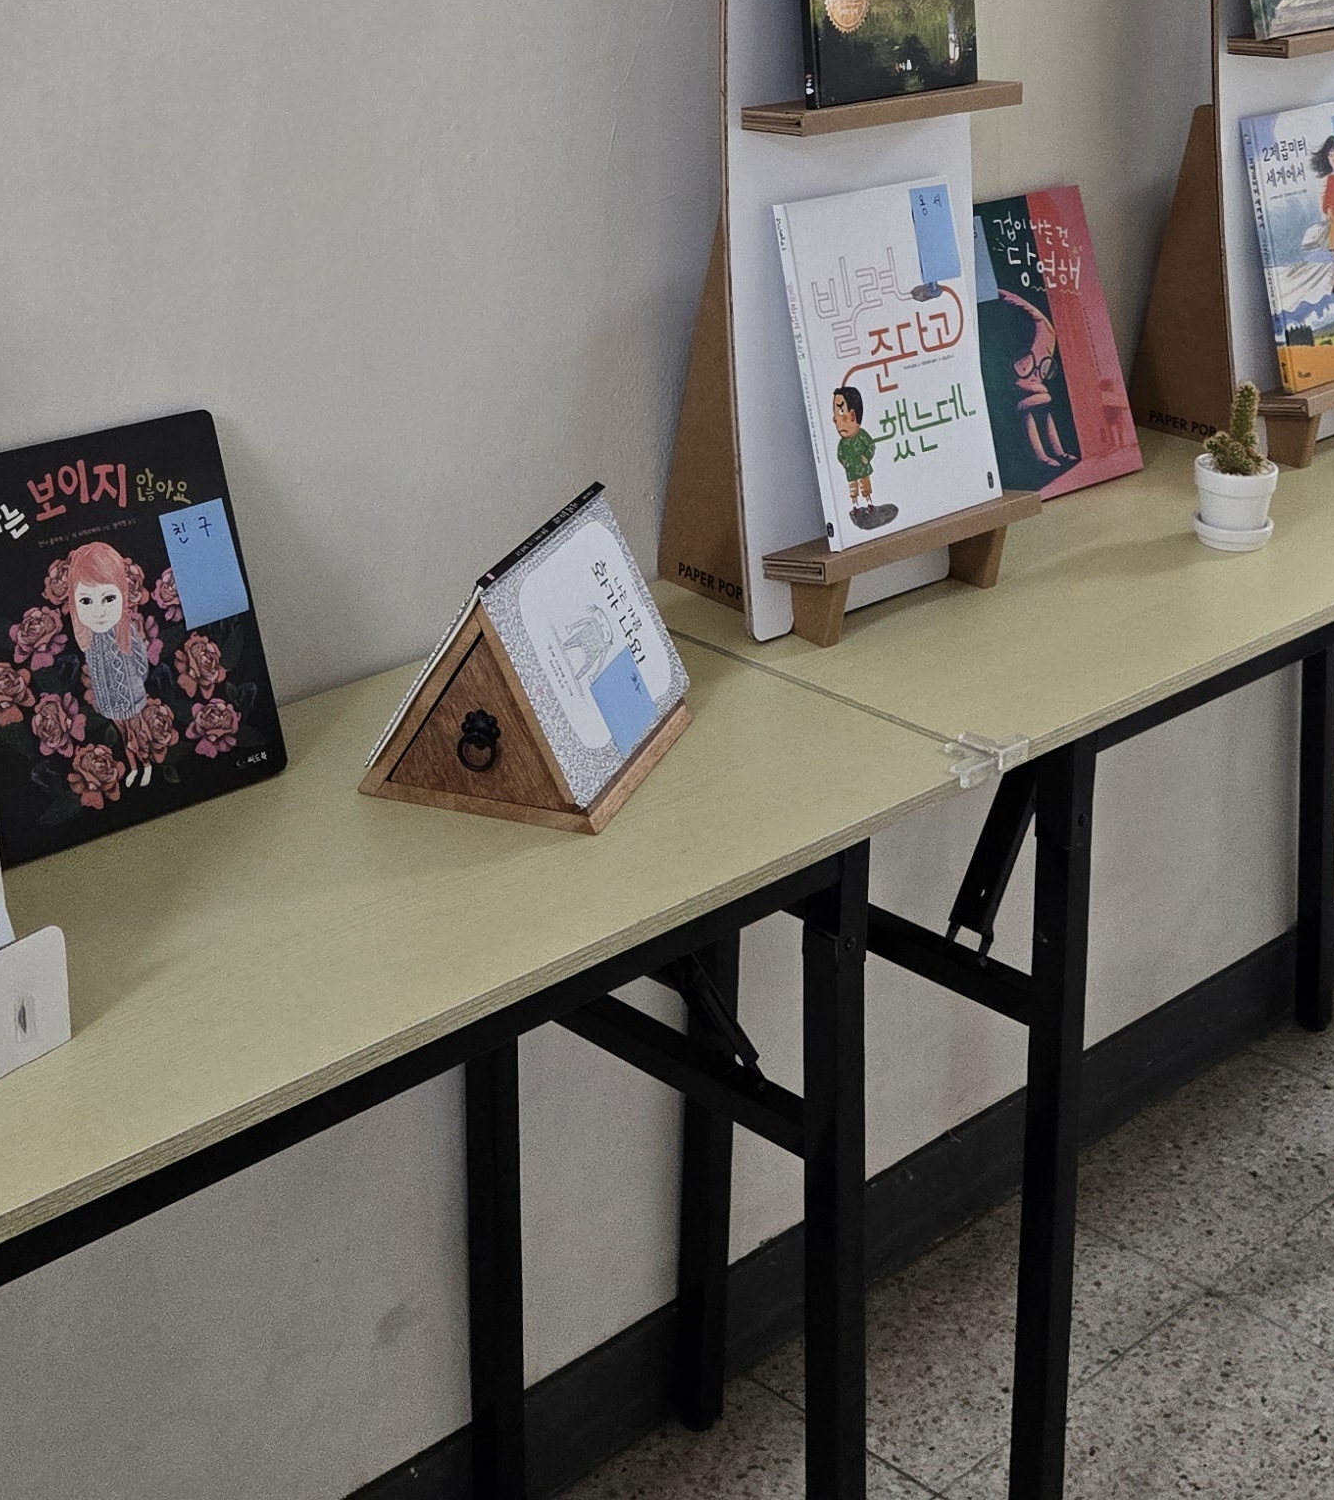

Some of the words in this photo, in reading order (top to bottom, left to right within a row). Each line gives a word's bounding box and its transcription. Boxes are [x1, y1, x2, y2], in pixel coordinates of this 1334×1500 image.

[1262, 137, 1308, 162] 2제곱미터
[1266, 162, 1306, 187] 세계에서
[993, 211, 1027, 242] 겁이
[1029, 218, 1053, 245] 나는
[1055, 226, 1070, 248] 건
[1007, 241, 1081, 290] 당연해
[867, 311, 953, 393] 준다고
[1148, 409, 1188, 431] PAPER
[26, 459, 127, 522] 보이지
[135, 467, 192, 505] 않아요
[171, 516, 213, 544] 친구
[678, 561, 715, 590] PAPER
[718, 578, 743, 600] POP
[591, 559, 619, 612] 화가
[618, 615, 646, 665] 나요!
